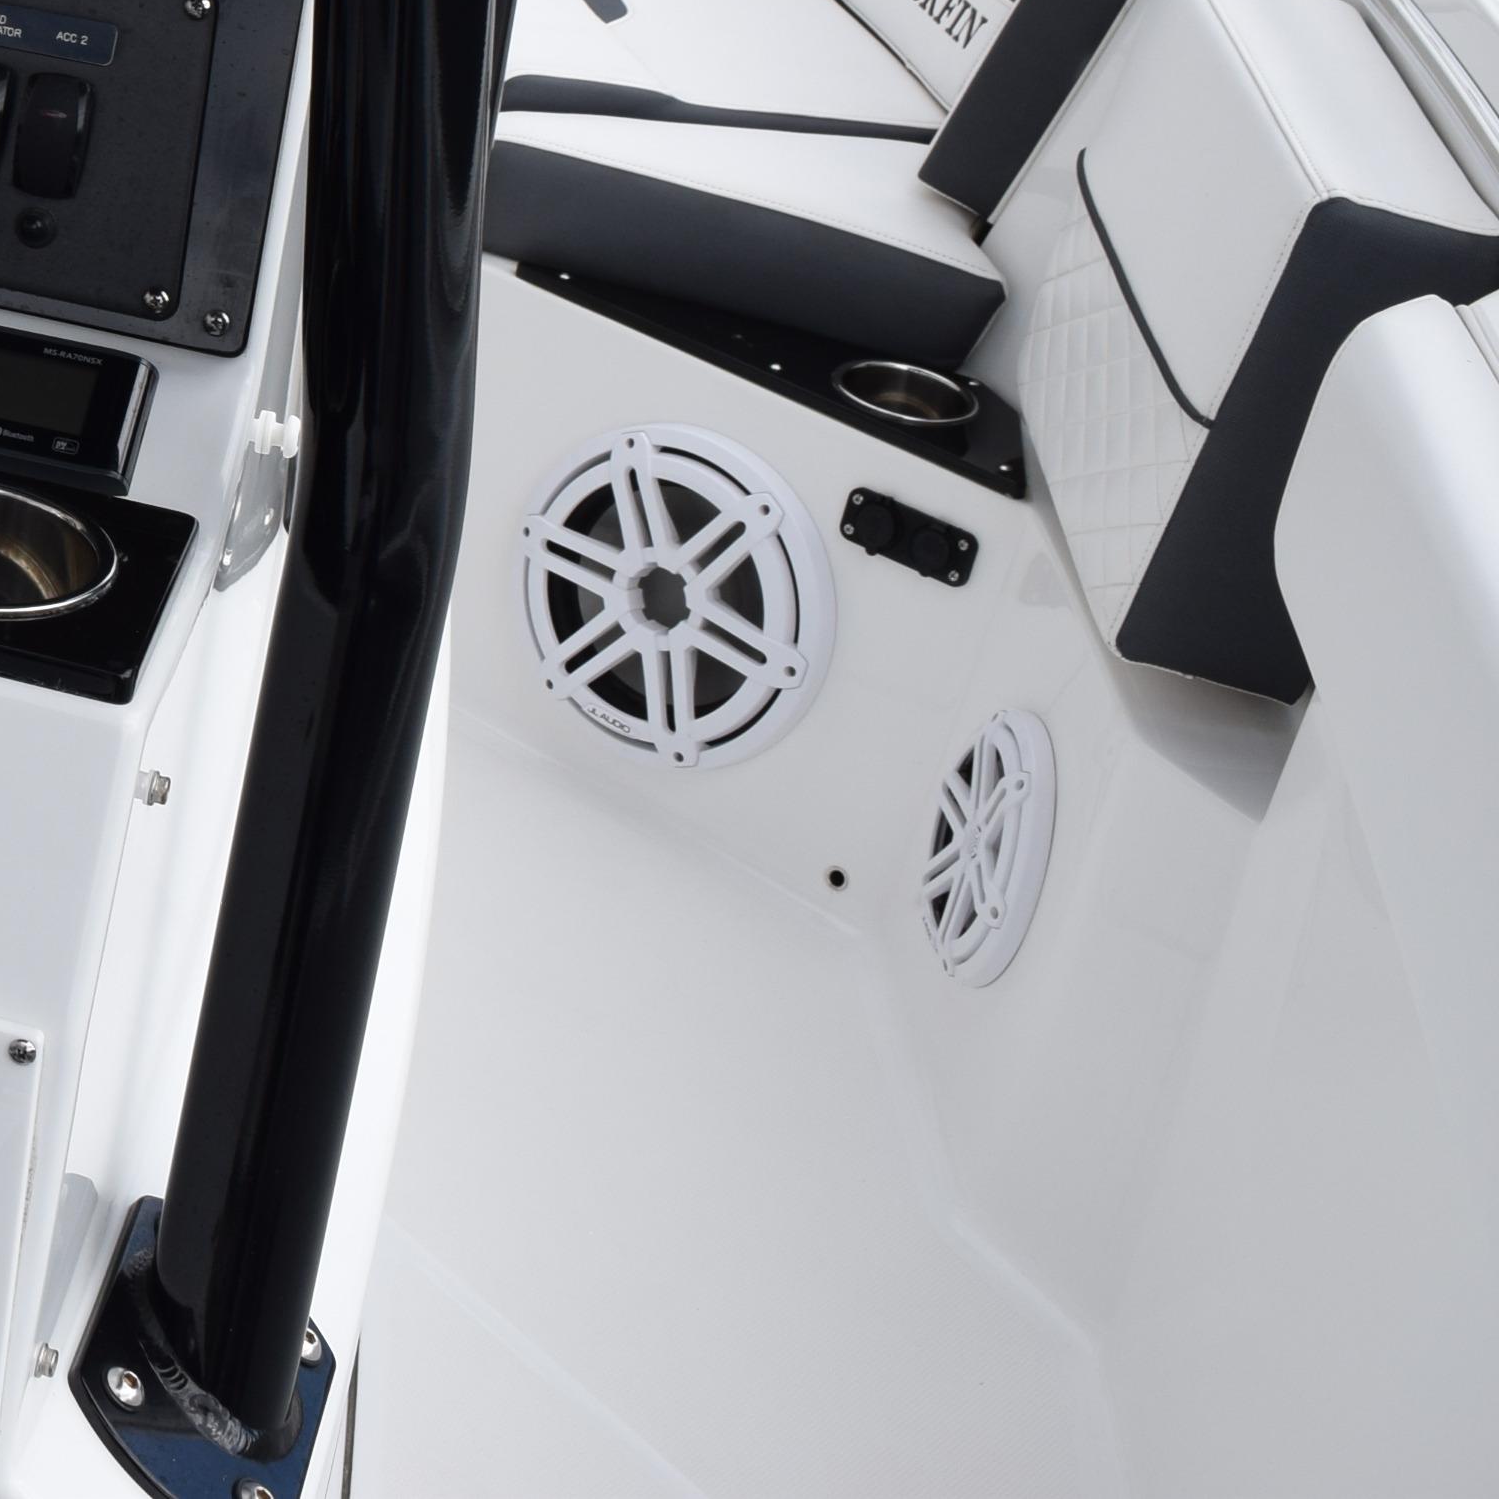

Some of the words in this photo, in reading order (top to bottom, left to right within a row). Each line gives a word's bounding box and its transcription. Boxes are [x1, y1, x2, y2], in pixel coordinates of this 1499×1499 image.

[56, 31, 77, 44] ACC
[80, 35, 88, 46] 2
[587, 708, 598, 716] JL
[600, 713, 631, 734] AUDIO
